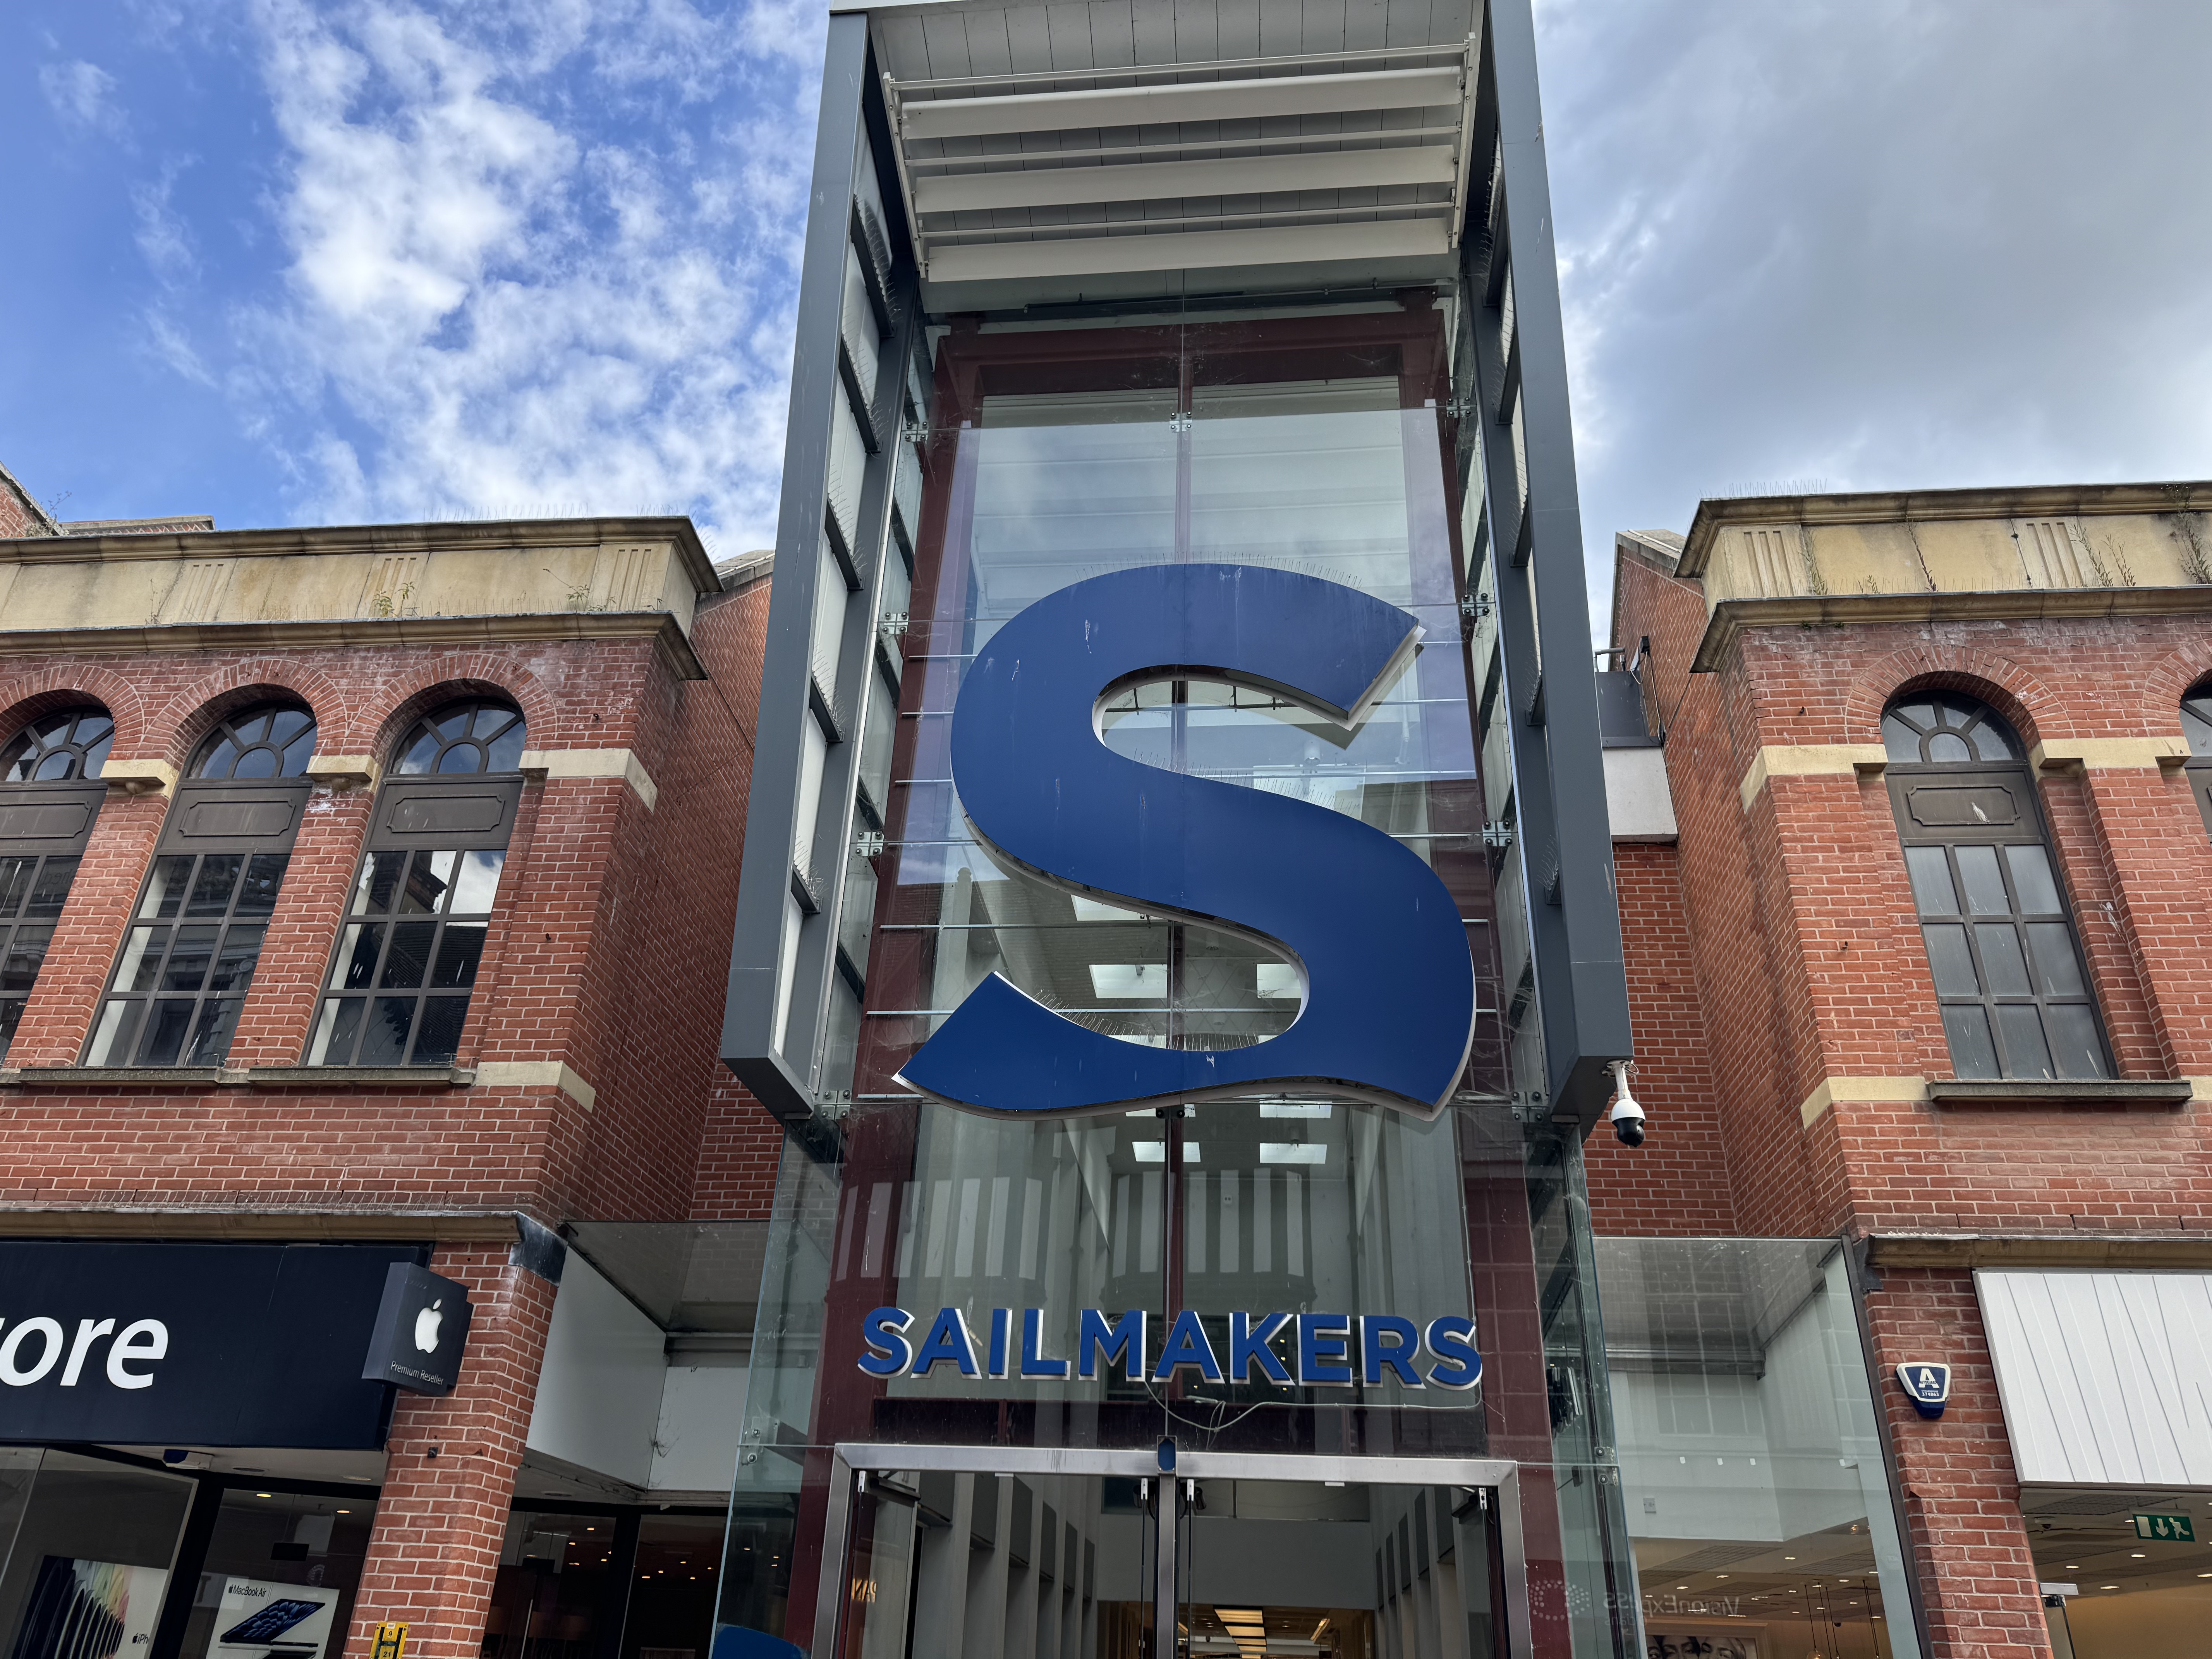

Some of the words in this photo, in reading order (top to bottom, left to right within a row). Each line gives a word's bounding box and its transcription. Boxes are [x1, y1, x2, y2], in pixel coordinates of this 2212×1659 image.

[892, 563, 1476, 1122] S
[0, 1317, 168, 1389] ore
[857, 1306, 1483, 1391] SAILMAKERS
[390, 1360, 419, 1378] Premium
[420, 1370, 444, 1385] Reseller
[1918, 1368, 1940, 1389] A
[232, 1585, 259, 1597] MacBook
[258, 1588, 267, 1597] Air
[137, 1633, 149, 1644] iPh
